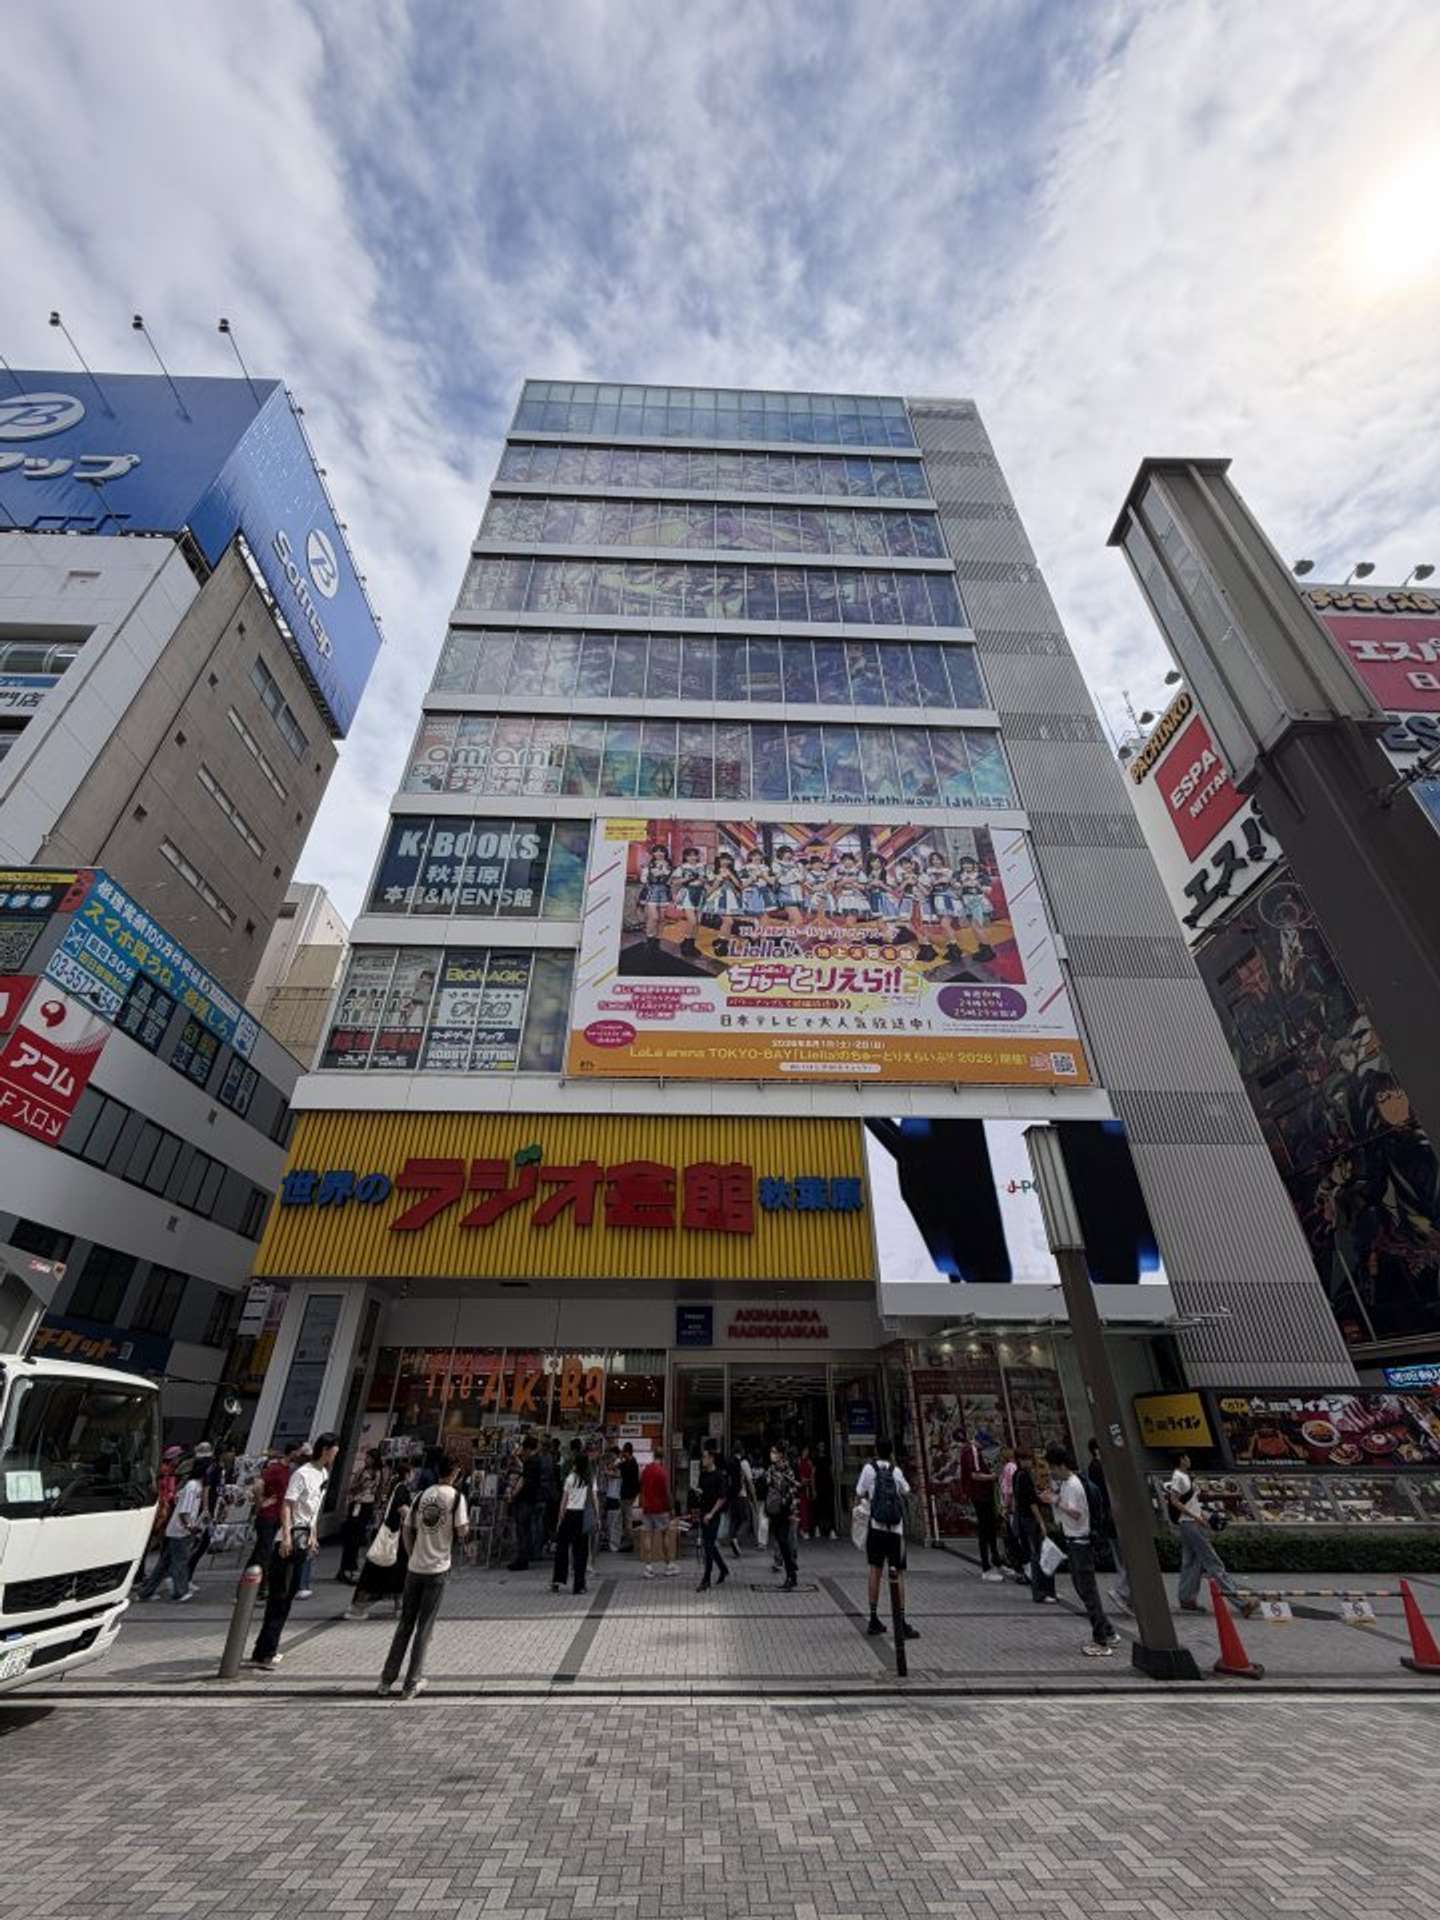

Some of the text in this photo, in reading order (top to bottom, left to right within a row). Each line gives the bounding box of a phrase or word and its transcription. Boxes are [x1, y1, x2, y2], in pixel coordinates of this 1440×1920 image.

[272, 529, 333, 660] Sofmap
[1130, 692, 1193, 785] PACHINKO
[1170, 749, 1217, 809] ESPA
[398, 830, 541, 859] K-BOOKS
[427, 865, 501, 884] 秋葉原
[49, 954, 122, 1016] 03-5577547
[10, 1041, 74, 1096] アコム
[281, 1146, 864, 1236] 世界の ラジオ会館 秋葉原
[728, 1326, 829, 1339] RADIOKAIKAN
[736, 1309, 821, 1322] AKIHABARA
